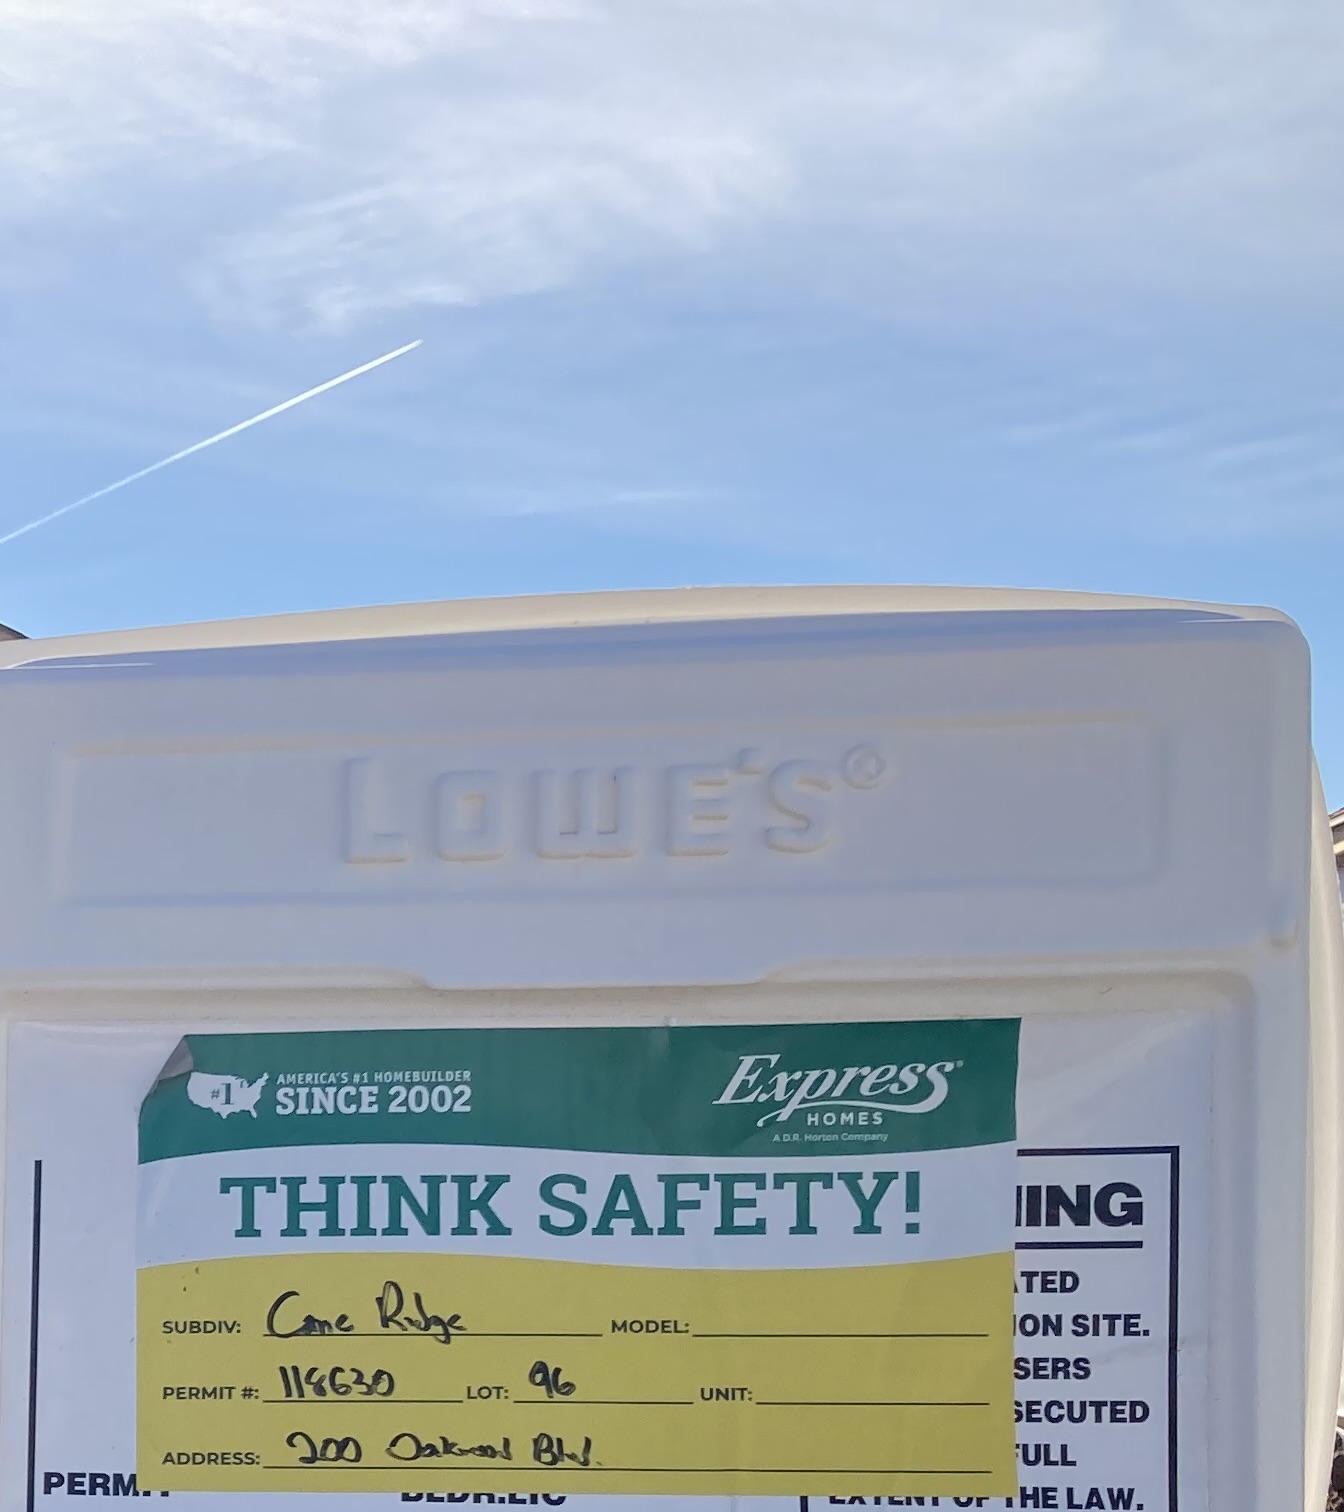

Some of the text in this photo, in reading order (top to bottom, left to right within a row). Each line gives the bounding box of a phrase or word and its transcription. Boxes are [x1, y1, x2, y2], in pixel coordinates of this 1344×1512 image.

[276, 1070, 472, 1086] AMERICA'S #1 HOMEBUILDER
[711, 1053, 956, 1128] Express
[275, 1084, 472, 1116] SINCE 2002
[806, 1111, 884, 1127] HOMES
[804, 1133, 839, 1142] Horton
[841, 1132, 889, 1143] Company
[219, 1170, 921, 1239] THINK SAFETY!
[161, 1319, 242, 1335] SUBDIV:
[610, 1319, 691, 1335] MODEL:
[1071, 1313, 1151, 1337] SITE.
[528, 1361, 576, 1399] 96
[162, 1385, 235, 1401] PERMIT
[466, 1385, 509, 1401] LOT:
[699, 1387, 754, 1402] UNIT:
[285, 1431, 363, 1464] 200
[161, 1451, 261, 1467] ADDRESS:
[1066, 1487, 1145, 1512] LAW.
